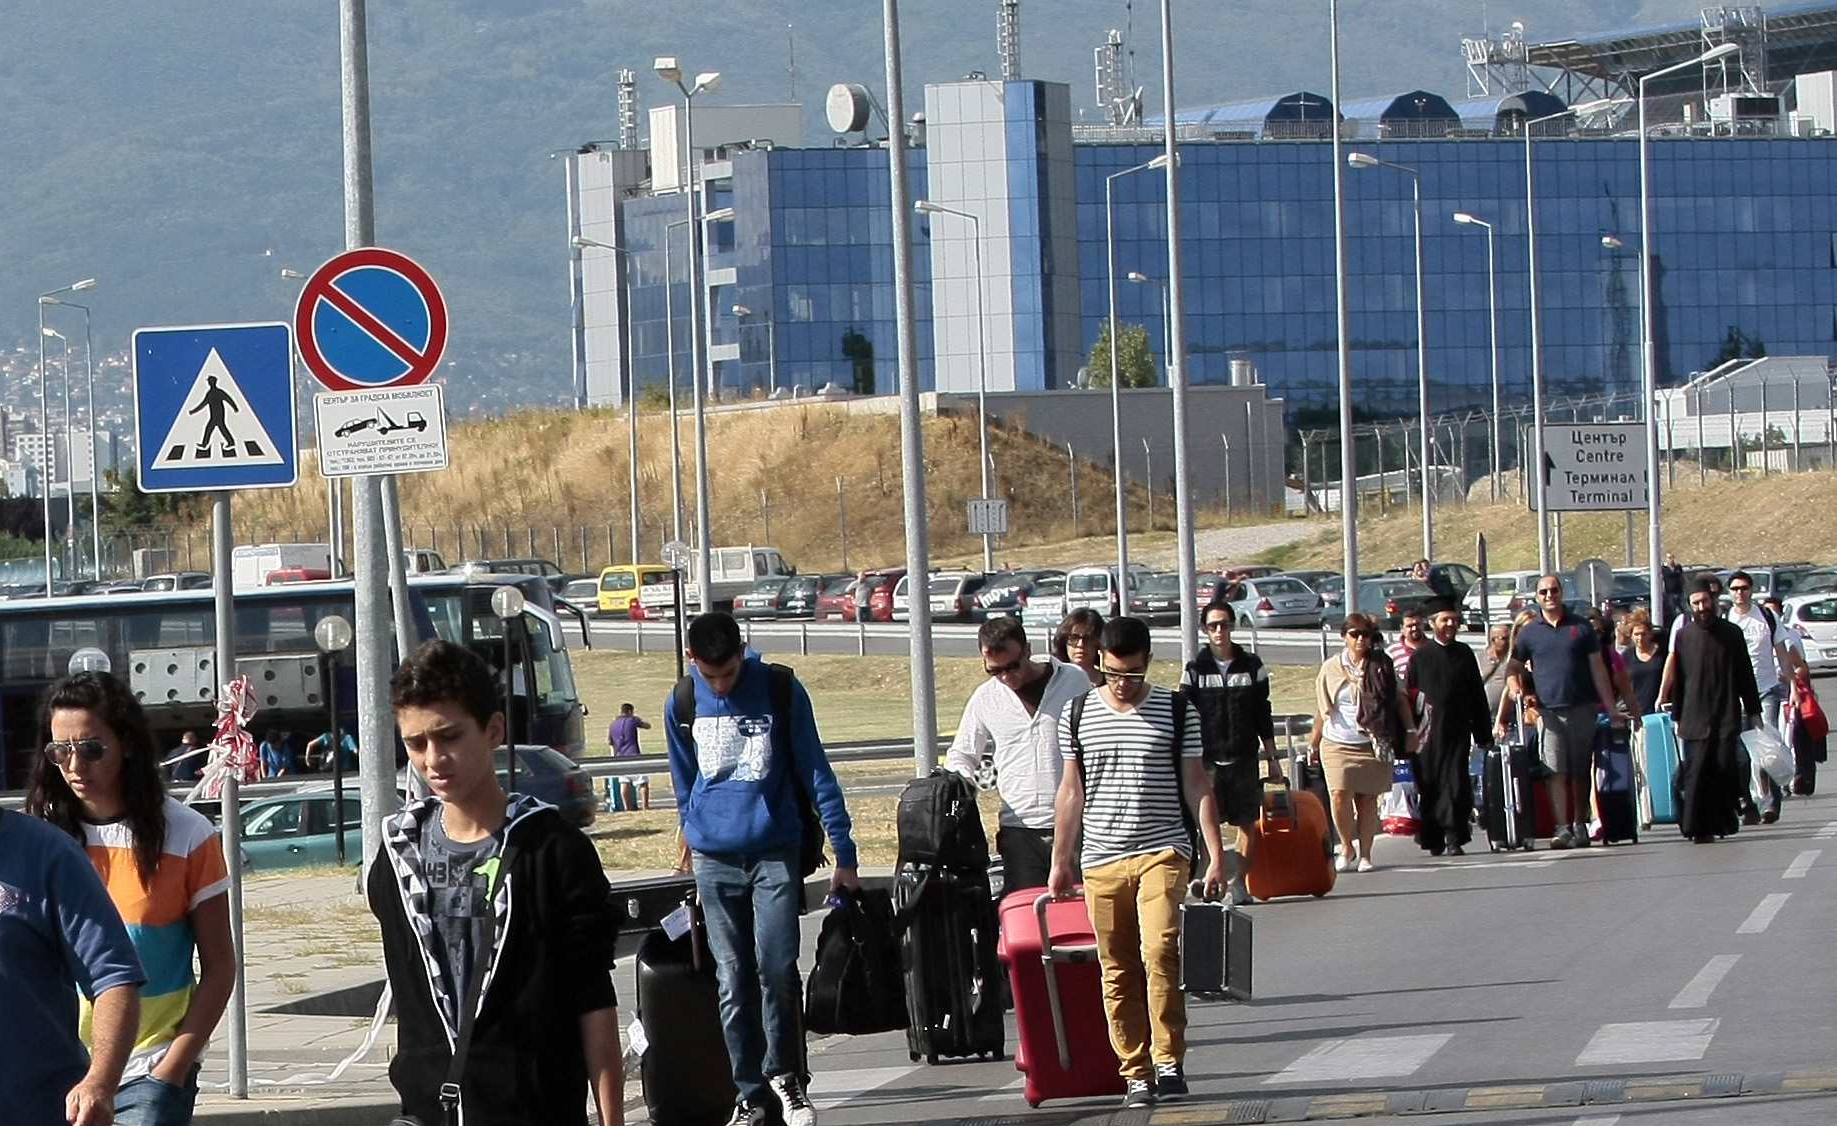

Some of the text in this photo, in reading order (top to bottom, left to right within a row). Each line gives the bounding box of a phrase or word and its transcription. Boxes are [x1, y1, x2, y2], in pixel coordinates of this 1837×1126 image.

[350, 395, 359, 403] ЗА
[1572, 431, 1626, 445] Център
[1576, 450, 1624, 462] Centre
[1565, 471, 1636, 487] Терминал
[1570, 490, 1633, 503] Terminal
[427, 861, 448, 884] 43
